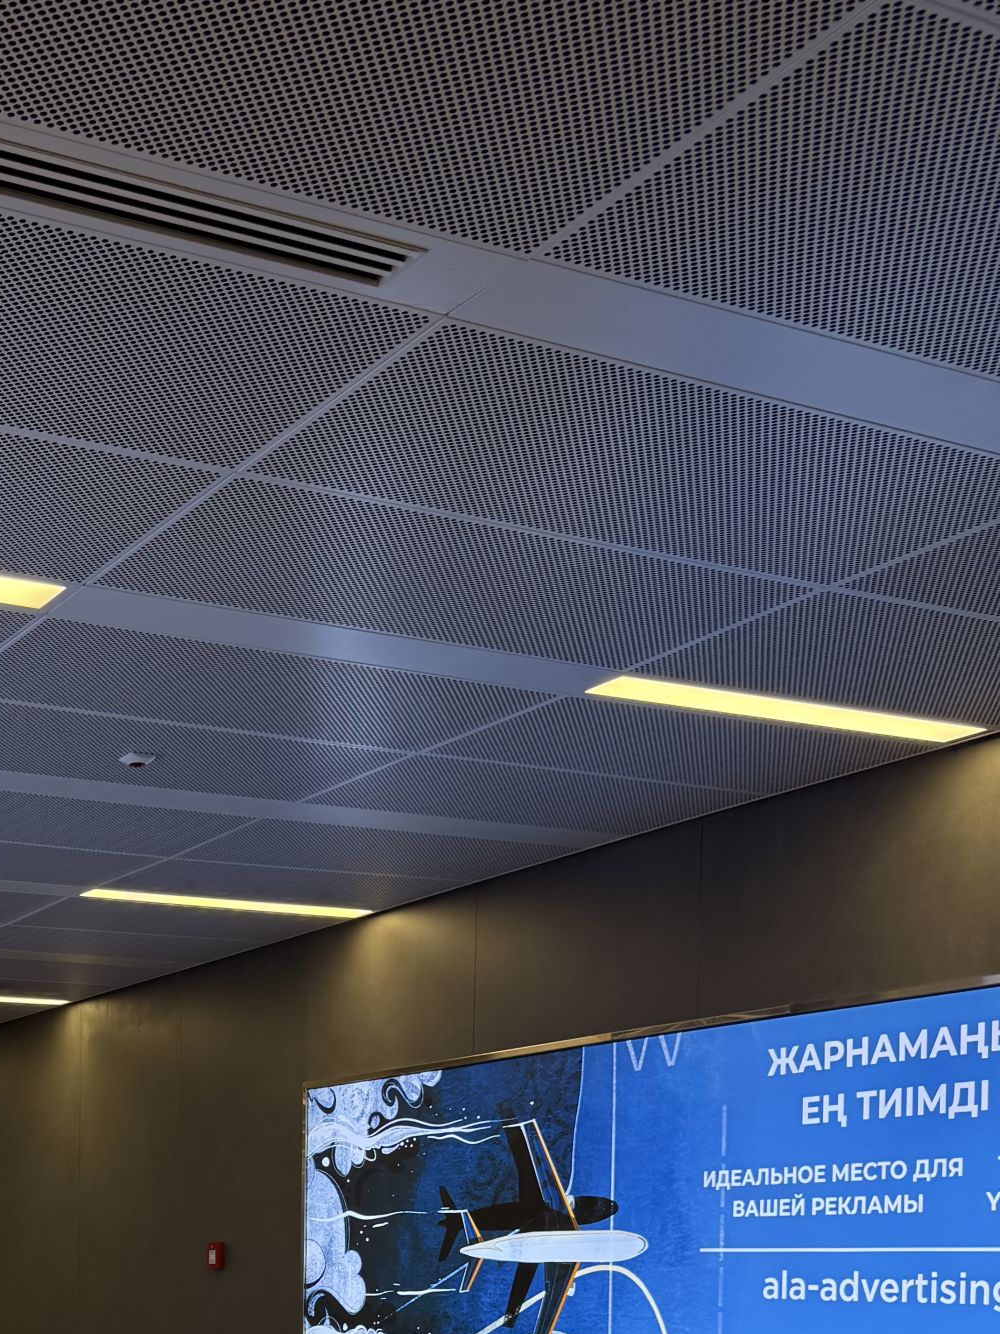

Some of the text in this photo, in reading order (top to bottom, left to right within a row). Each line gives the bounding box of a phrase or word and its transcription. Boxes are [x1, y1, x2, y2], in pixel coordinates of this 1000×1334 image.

[802, 1080, 989, 1127] ЕҢ ТИІМДІ
[703, 1157, 963, 1190] ИДЕАЛЬНОЕ МЕСТО ДЛЯ
[732, 1194, 924, 1217] ВАШЕЙ РЕКЛАМЫ
